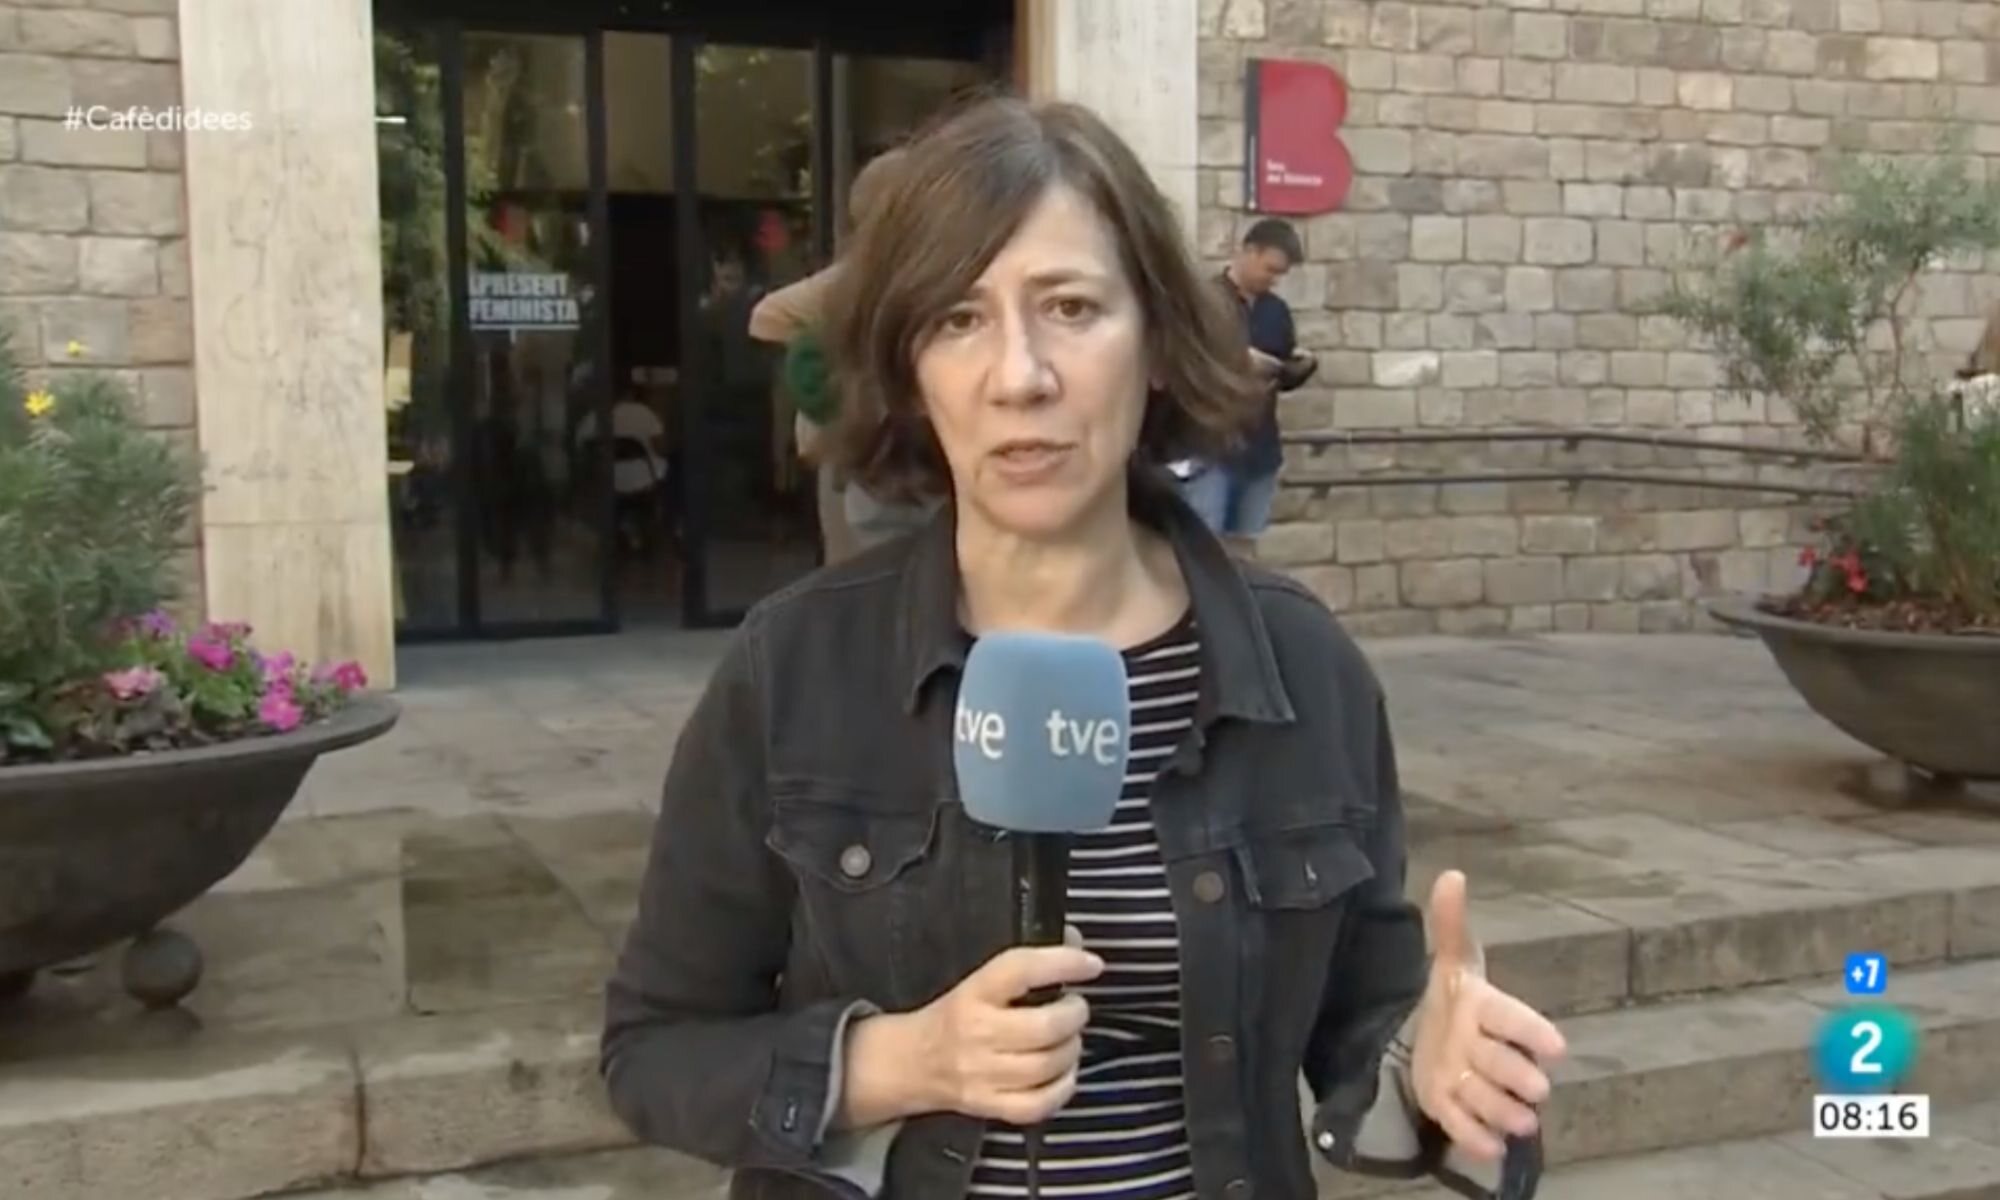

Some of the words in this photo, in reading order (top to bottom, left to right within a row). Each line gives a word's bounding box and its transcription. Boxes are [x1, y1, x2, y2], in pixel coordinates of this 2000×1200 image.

[469, 298, 579, 321] FEMINISTA
[956, 694, 1005, 760] tve
[1046, 708, 1120, 766] tve
